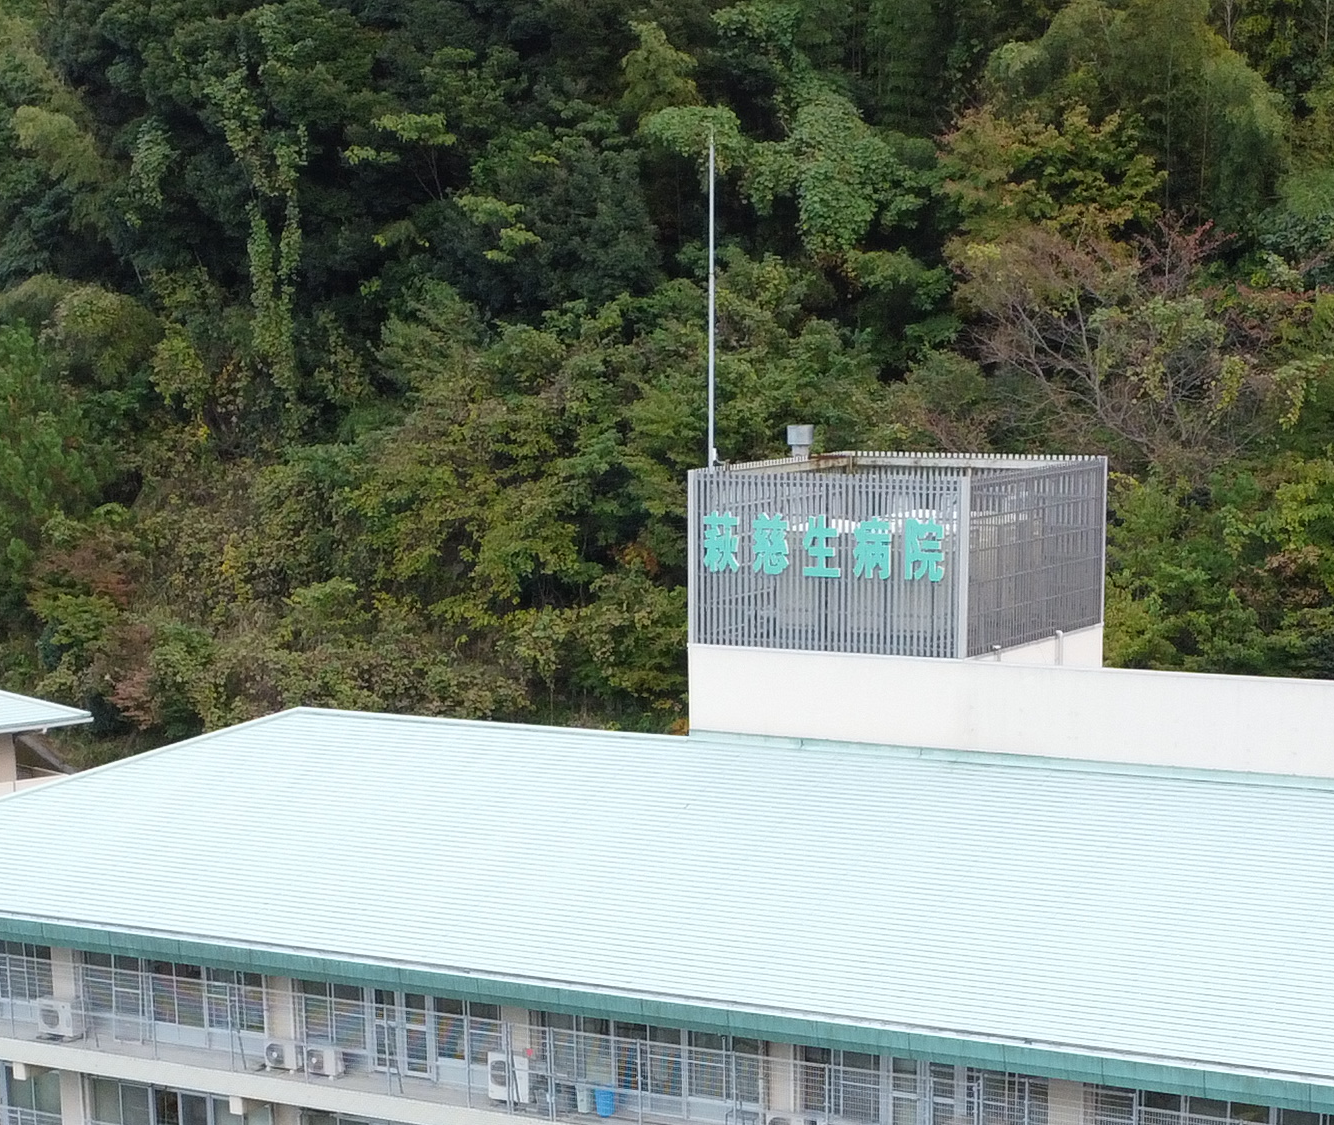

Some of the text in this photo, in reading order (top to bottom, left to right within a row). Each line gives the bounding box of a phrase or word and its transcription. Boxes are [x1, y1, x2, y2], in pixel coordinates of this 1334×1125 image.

[703, 511, 945, 582] 萩慈生病院
